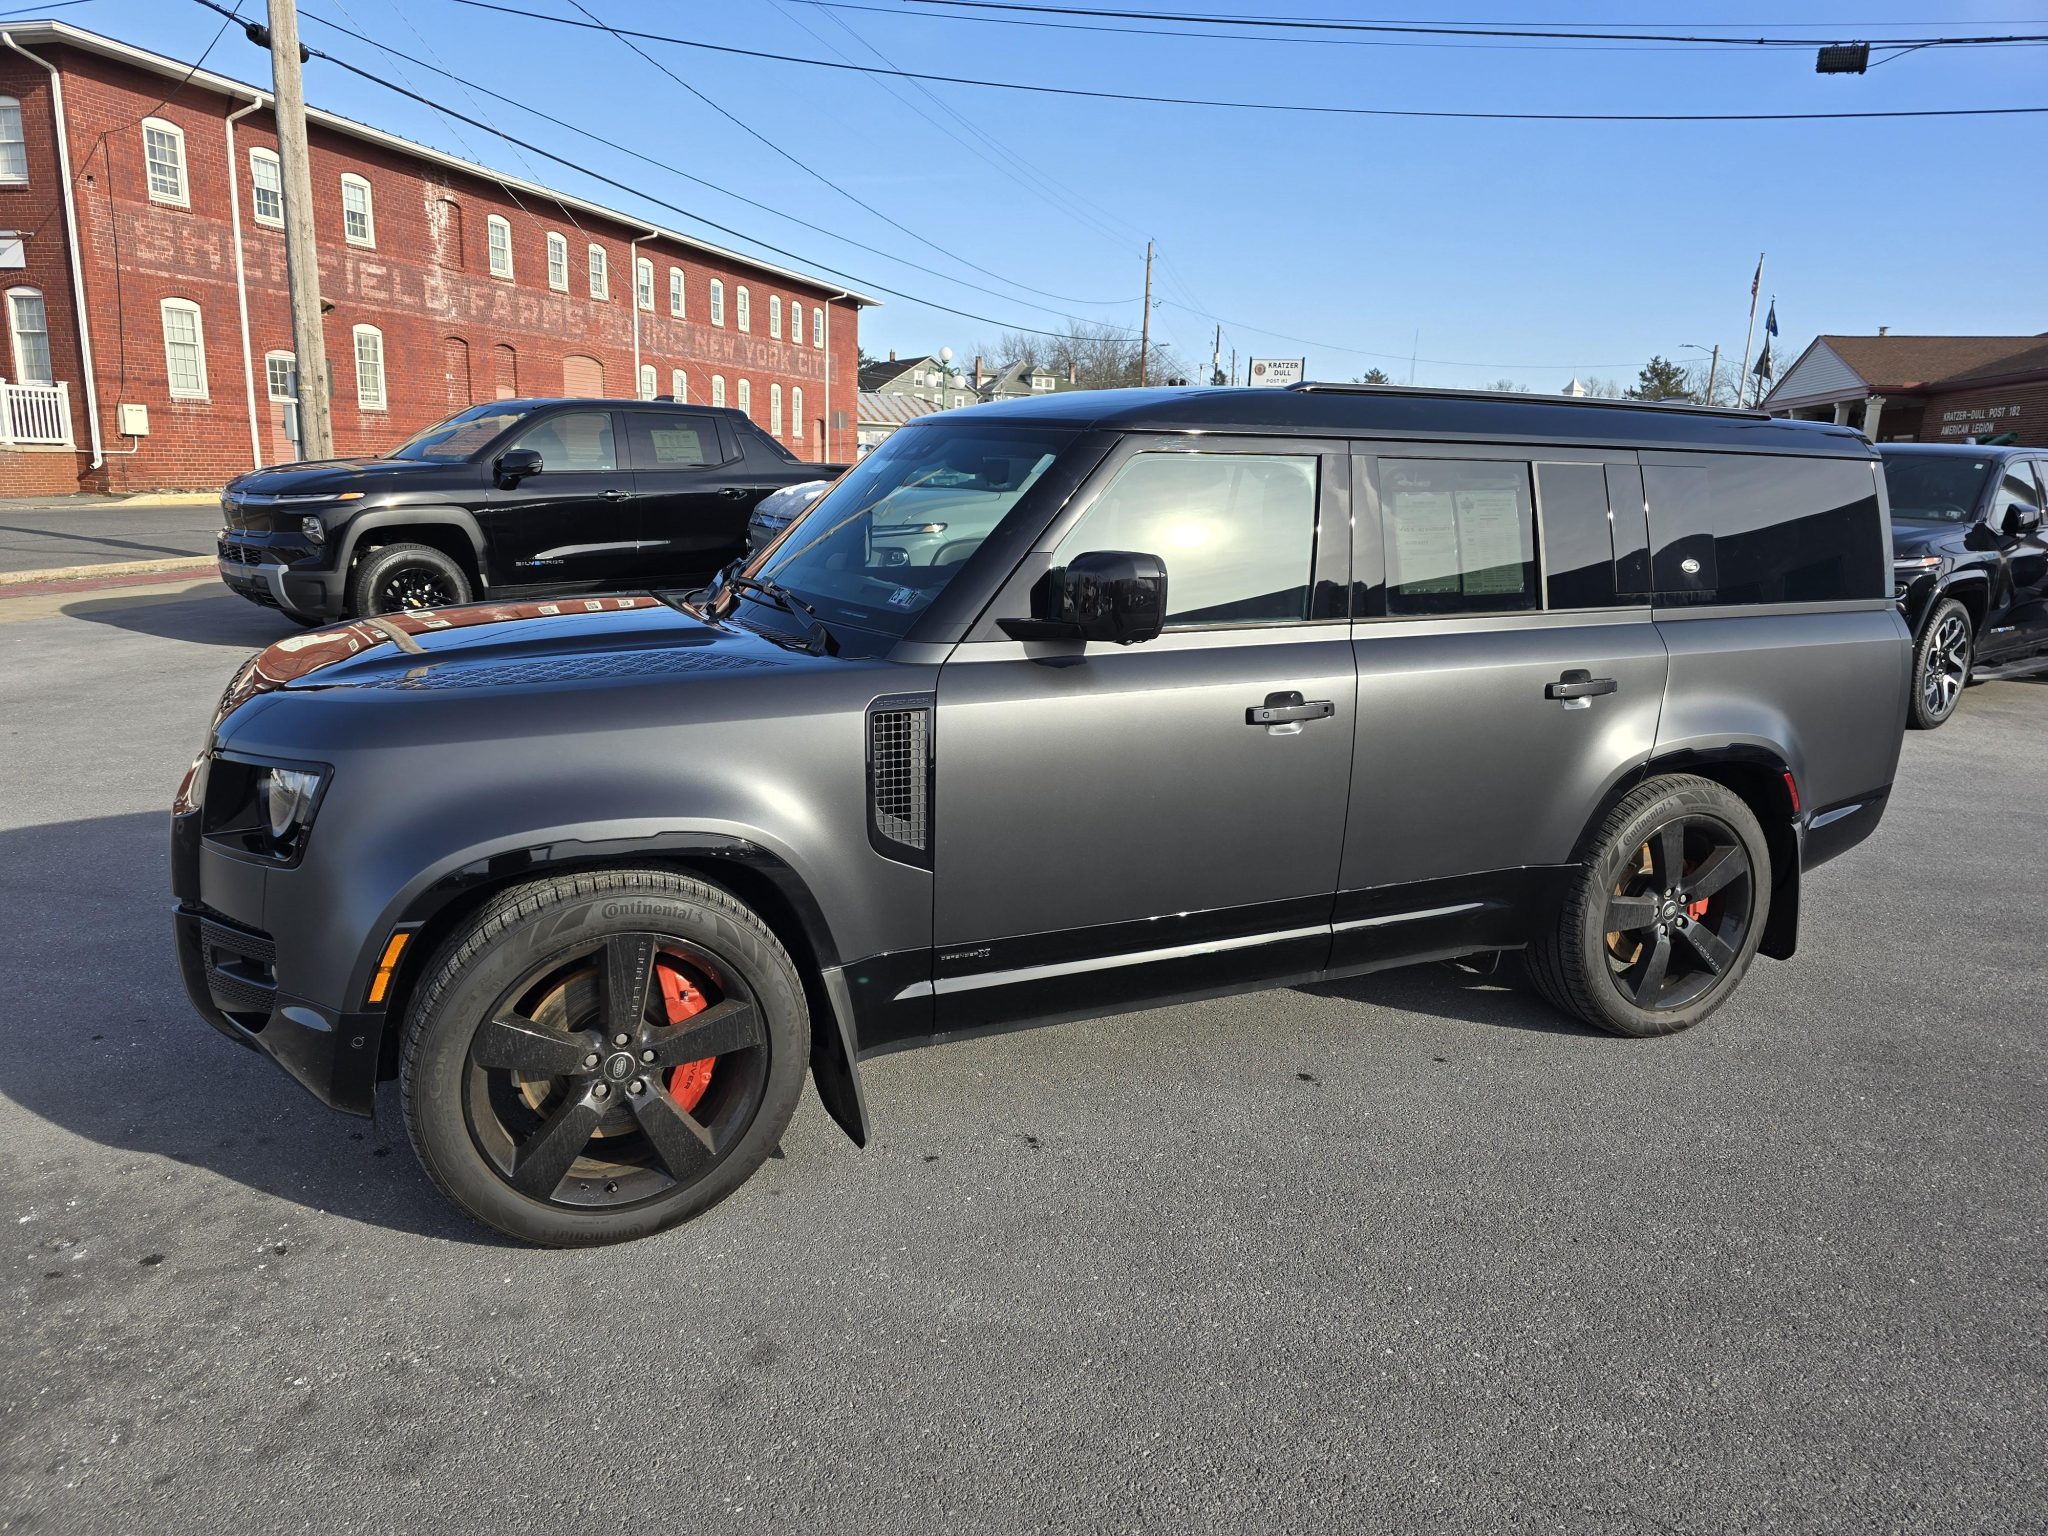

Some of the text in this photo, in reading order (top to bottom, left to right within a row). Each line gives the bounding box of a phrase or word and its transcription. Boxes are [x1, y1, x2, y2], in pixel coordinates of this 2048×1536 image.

[694, 330, 735, 361] NEW
[744, 340, 790, 371] YORK
[798, 351, 830, 377] CIT
[1943, 405, 2021, 422] KRATZER-DULL POST 182
[1940, 422, 1995, 436] AMERICAN LEGION
[1622, 801, 1668, 847] Continental
[601, 900, 694, 921] Continental
[683, 1061, 698, 1090] OVER
